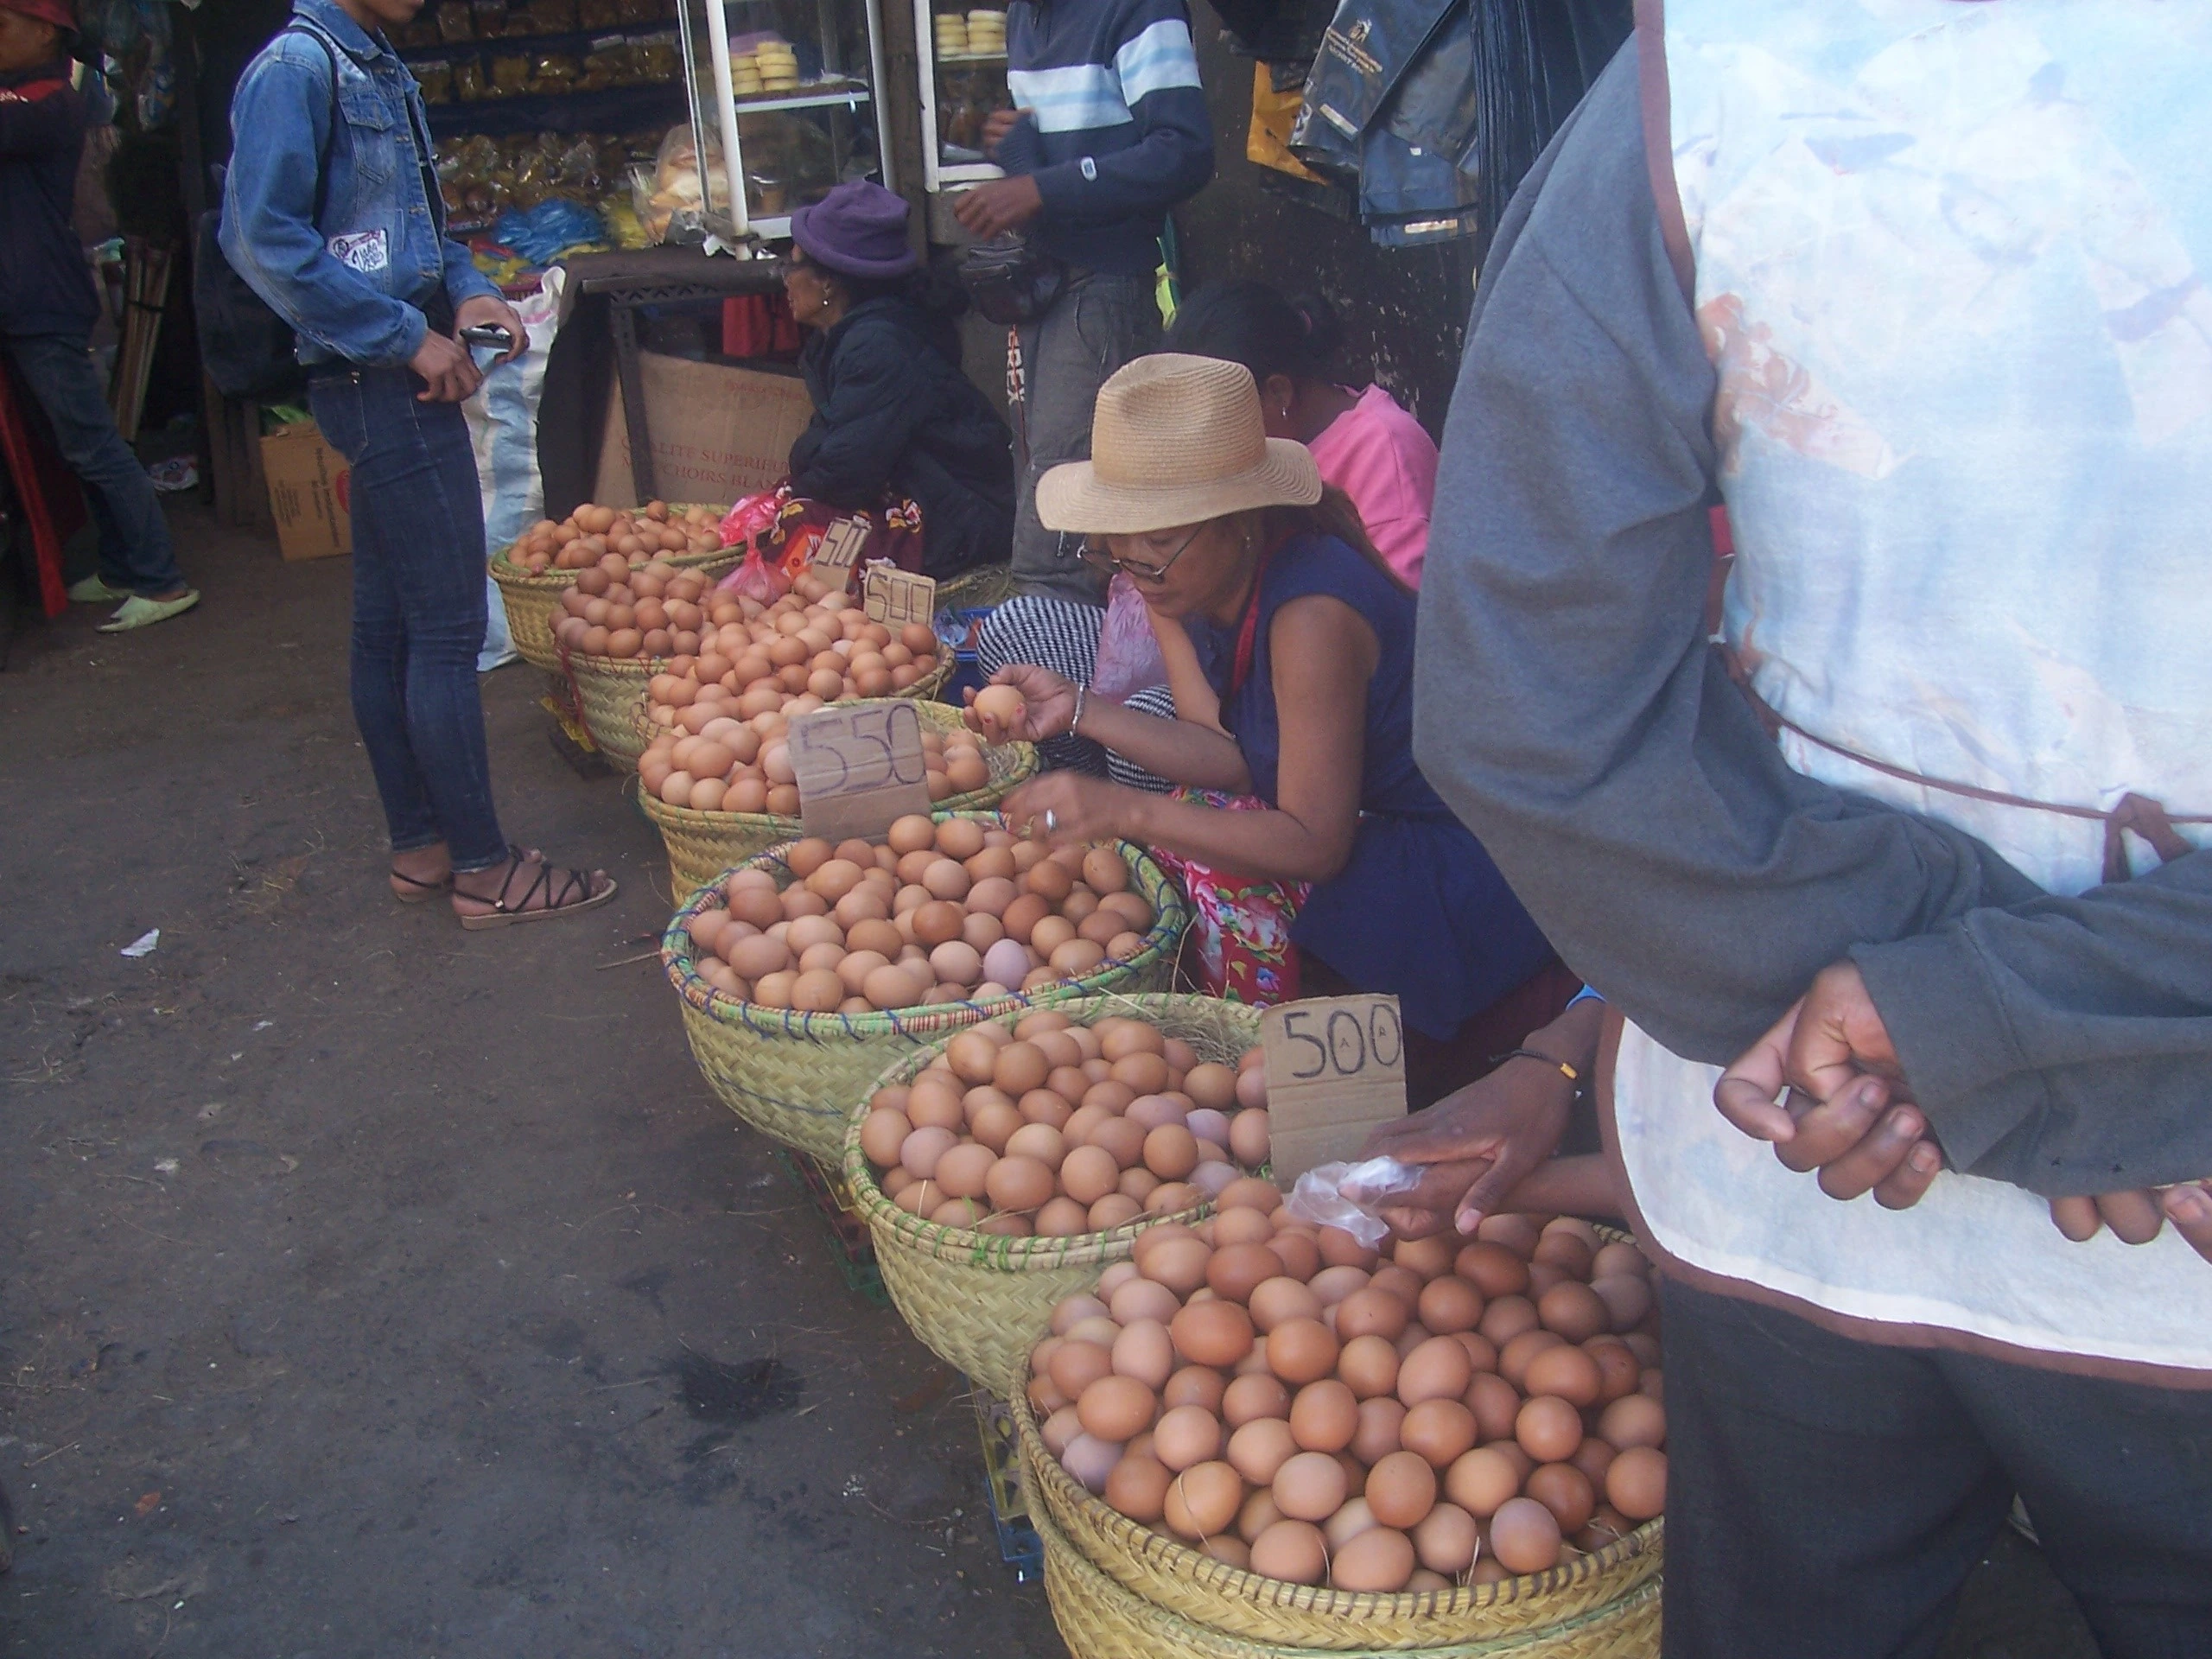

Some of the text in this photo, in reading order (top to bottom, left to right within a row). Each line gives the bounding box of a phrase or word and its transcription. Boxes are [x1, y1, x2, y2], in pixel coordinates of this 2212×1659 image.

[867, 572, 932, 624] 500
[801, 703, 927, 795] 550
[1284, 1002, 1402, 1079] 500
